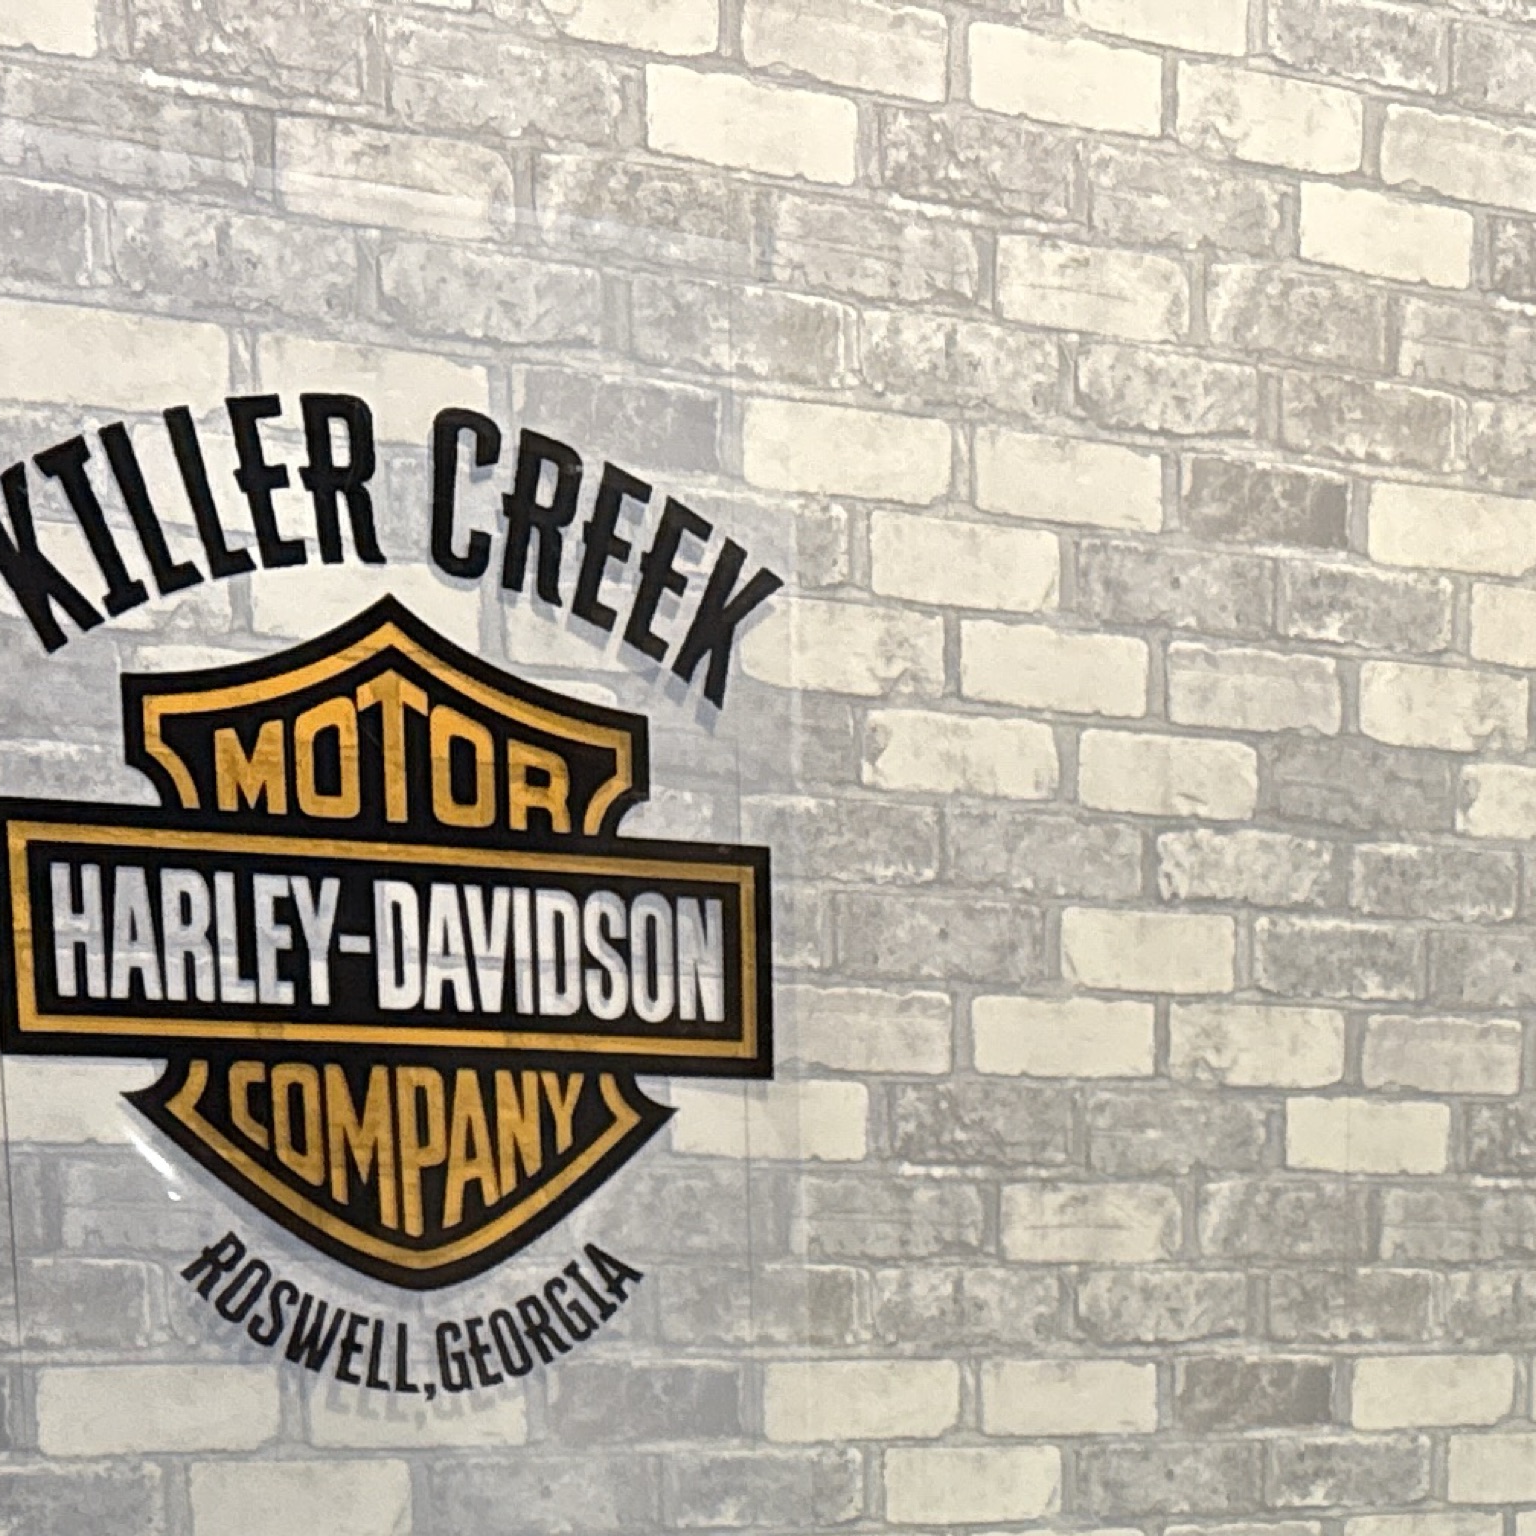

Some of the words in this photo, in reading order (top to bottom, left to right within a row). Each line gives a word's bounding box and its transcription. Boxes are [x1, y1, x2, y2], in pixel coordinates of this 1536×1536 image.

[429, 408, 784, 709] CREEK
[214, 669, 571, 836] MOTOR
[49, 860, 726, 1024] HARLEY-DAVIDSON
[227, 1059, 584, 1237] COMPANY
